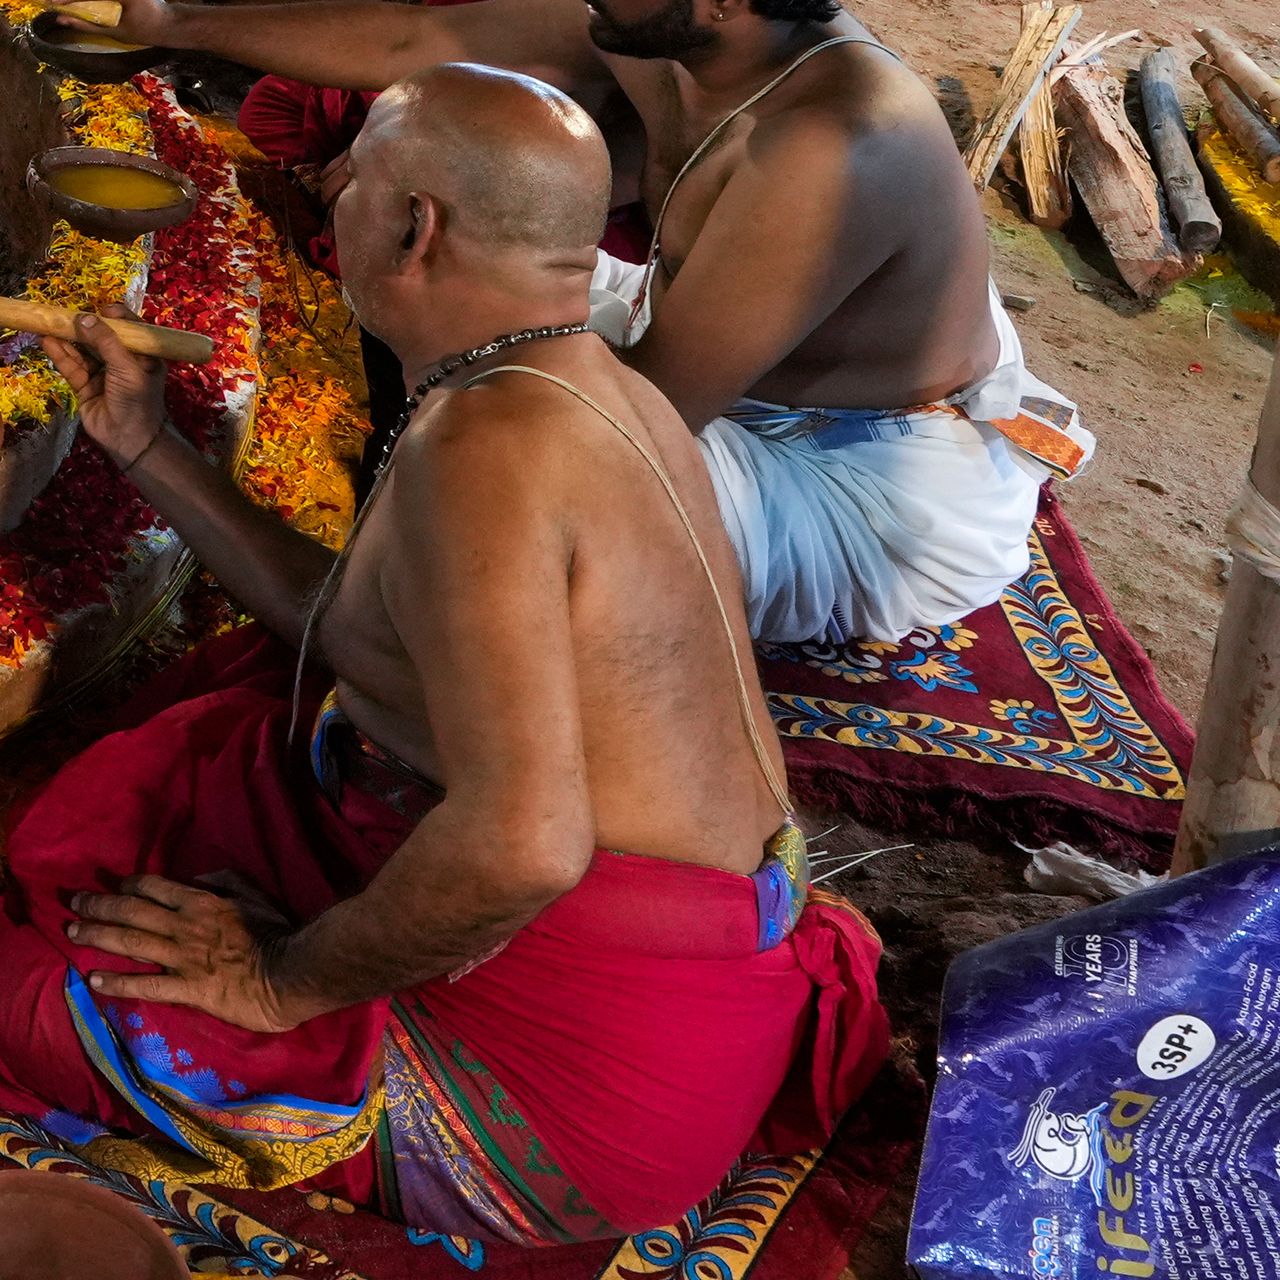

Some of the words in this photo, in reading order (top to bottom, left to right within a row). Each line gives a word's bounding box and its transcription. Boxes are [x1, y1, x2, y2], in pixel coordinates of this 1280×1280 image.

[1086, 934, 1102, 981] YEARS
[1128, 939, 1138, 983] HAPPINESS
[1128, 984, 1137, 996] OF
[1236, 963, 1258, 1026] Aqua-Food
[1253, 968, 1272, 1010] Nexgen
[1250, 1012, 1263, 1027] by
[1151, 1024, 1198, 1073] 3SP+
[1187, 1084, 1219, 1129] renowned
[1207, 1105, 1222, 1118] by
[1159, 1123, 1180, 1152] Indian
[1172, 1132, 1190, 1160] world
[1134, 1175, 1143, 1205] TRUE
[1147, 1179, 1158, 1193] of
[1162, 1164, 1173, 1195] years
[1187, 1179, 1205, 1200] and
[1151, 1200, 1165, 1233] result
[1162, 1197, 1175, 1212] 25
[1173, 1178, 1200, 1229] powered
[1205, 1178, 1236, 1232] produced
[1138, 1212, 1148, 1234] THE
[1167, 1215, 1183, 1237] and
[1199, 1205, 1231, 1268] processing
[1231, 1201, 1257, 1248] nutrition
[1175, 1241, 1192, 1263] USA
[1191, 1235, 1202, 1244] is
[1228, 1240, 1239, 1249] is
[1196, 1250, 1217, 1278] plant
